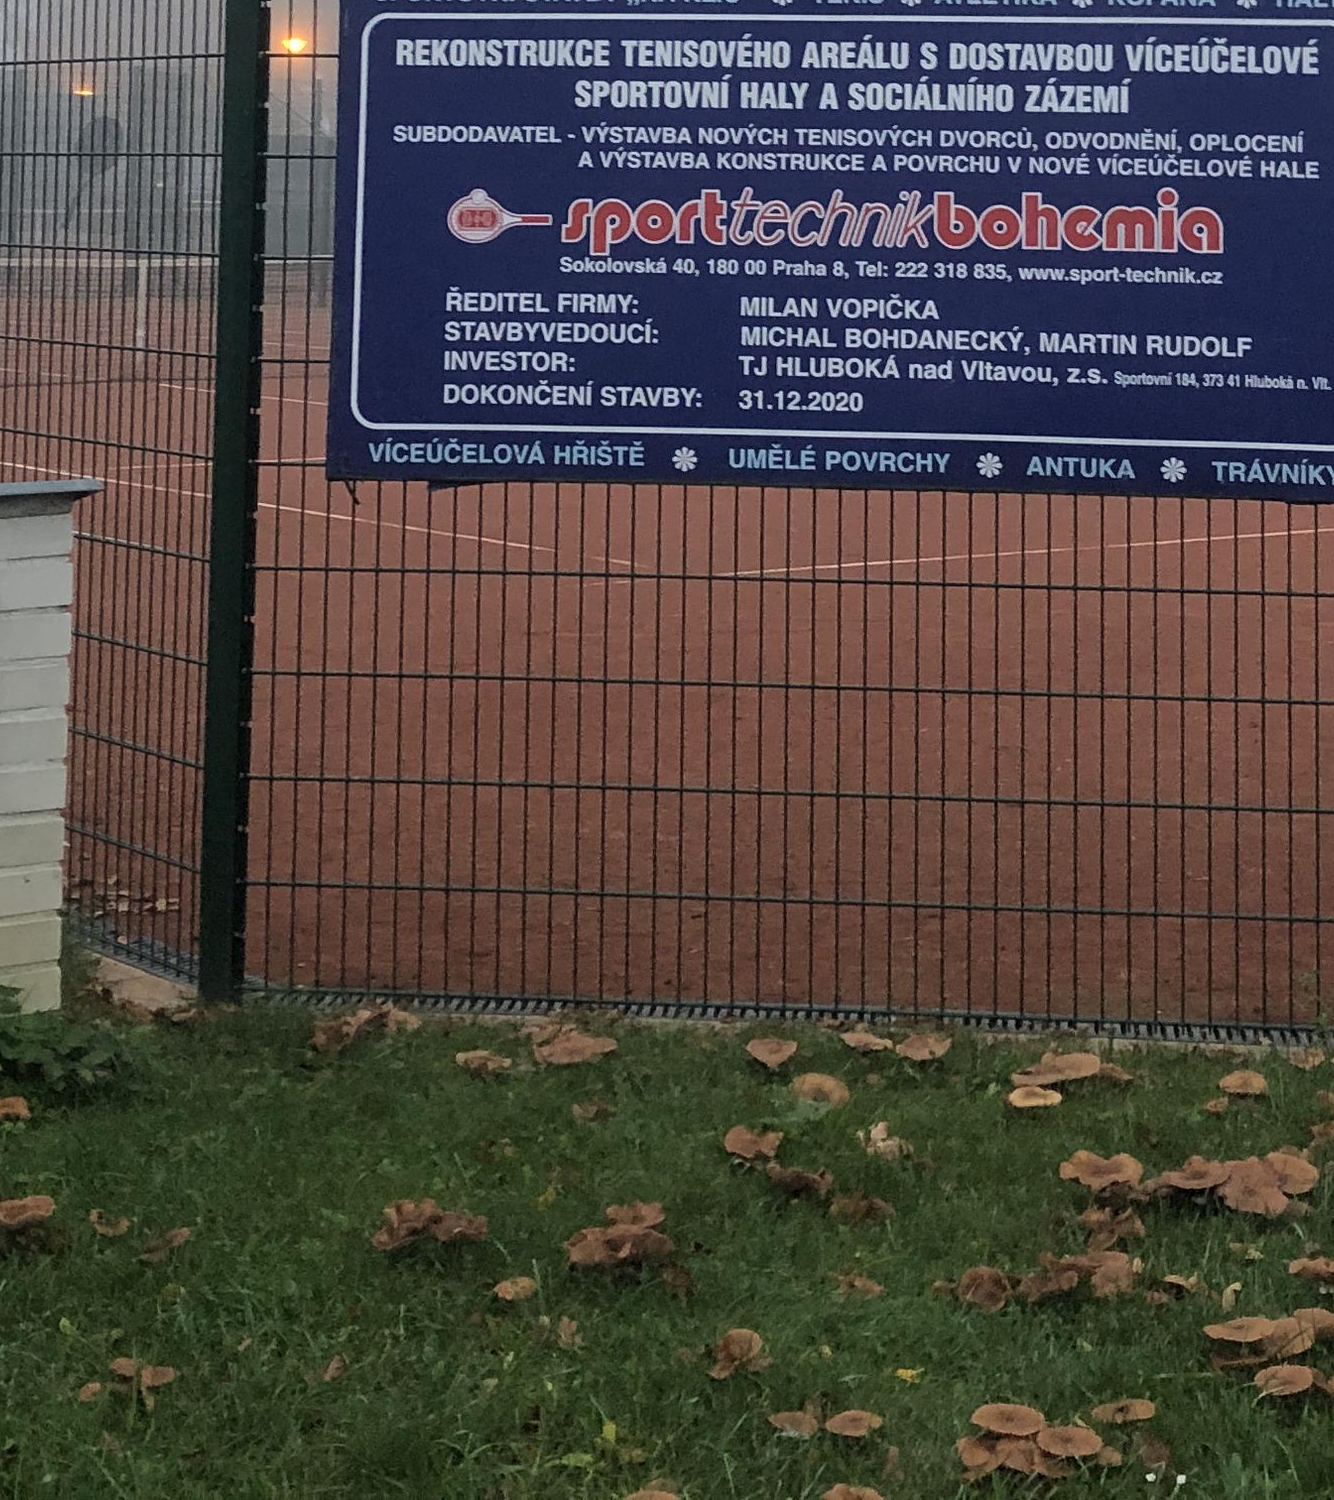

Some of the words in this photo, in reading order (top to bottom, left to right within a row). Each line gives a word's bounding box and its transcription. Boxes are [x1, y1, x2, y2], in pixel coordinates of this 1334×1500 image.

[396, 39, 610, 67] REKONSTRUKCE
[621, 34, 791, 68] TENISOVÉHO
[801, 35, 909, 69] AREÁLU
[920, 42, 938, 70] S
[950, 43, 1113, 72] DOSTAVBOU
[1124, 37, 1319, 74] VÍCEÚČELOVÉ
[575, 74, 732, 108] SPORTOVNÍ
[741, 82, 809, 109] HALY
[819, 83, 839, 109] A
[848, 76, 1014, 112] SOCIÁLNÍHO
[1025, 77, 1131, 113] ZÁZEMÍ
[393, 125, 562, 142] SUBDODAVATEL
[581, 122, 691, 145] VÝSTAVBA
[699, 124, 788, 145] NOVÝCH
[794, 125, 932, 147] TENISOVÝCH
[940, 127, 1038, 151] DVORCŮ,
[1045, 128, 1183, 153] ODVODNĚNÍ,
[1190, 131, 1304, 153] OPLOCENÍ
[578, 151, 593, 167] A
[600, 147, 710, 169] VÝSTAVBA
[717, 153, 864, 171] KONSTRUKCE
[872, 155, 887, 171] A
[894, 155, 1000, 173] POVRCHU
[1007, 157, 1021, 173] V
[1029, 153, 1090, 175] NOVÉ
[1097, 153, 1253, 178] VÍCEÚČELOVÉ
[1261, 161, 1319, 179] HALE
[560, 257, 667, 274] Sokolovská
[673, 259, 700, 276] 40,
[707, 259, 739, 274] 180
[745, 260, 766, 275] 00
[773, 260, 827, 276] Praha
[833, 261, 849, 279] 8,
[855, 261, 888, 277] Tel:
[895, 262, 928, 277] 222
[934, 263, 968, 278] 318
[974, 264, 1012, 282] 835,
[1018, 267, 1223, 285] www.sport-technik.cz
[446, 287, 550, 312] ŘEDITEL
[558, 293, 638, 313] FIRMY:
[741, 297, 817, 317] MILAN
[826, 294, 939, 319] VOPIČKA
[445, 318, 658, 343] STAVBYVEDOUCÍ:
[741, 326, 837, 347] MICHAL
[845, 326, 1030, 355] BOHDANECKÝ,
[1040, 333, 1137, 354] MARTIN
[1147, 335, 1252, 357] RUDOLF
[444, 351, 575, 371] INVESTOR:
[739, 356, 767, 376] TJ
[776, 355, 900, 378] HLUBOKÁ
[909, 360, 952, 380] nad
[961, 360, 1059, 386] Vltavou,
[1067, 368, 1108, 384] z.s.
[1114, 371, 1172, 388] Sportovní
[1175, 373, 1199, 388] 184,
[1203, 374, 1224, 387] 373
[1226, 374, 1240, 388] 41
[1245, 375, 1293, 389] Hluboká
[1297, 378, 1309, 390] n.
[1312, 377, 1332, 390] Vlt.
[444, 380, 593, 405] DOKONČENÍ
[601, 386, 702, 407] STAVBY:
[739, 390, 863, 412] 31.12.2020
[369, 438, 545, 464] VÍCEÚČELOVÁ
[554, 440, 644, 466] HŘIŠTĚ
[729, 444, 816, 469] UMĚLÉ
[826, 451, 950, 473] POVRCHY
[1027, 456, 1135, 478] ANTUKA
